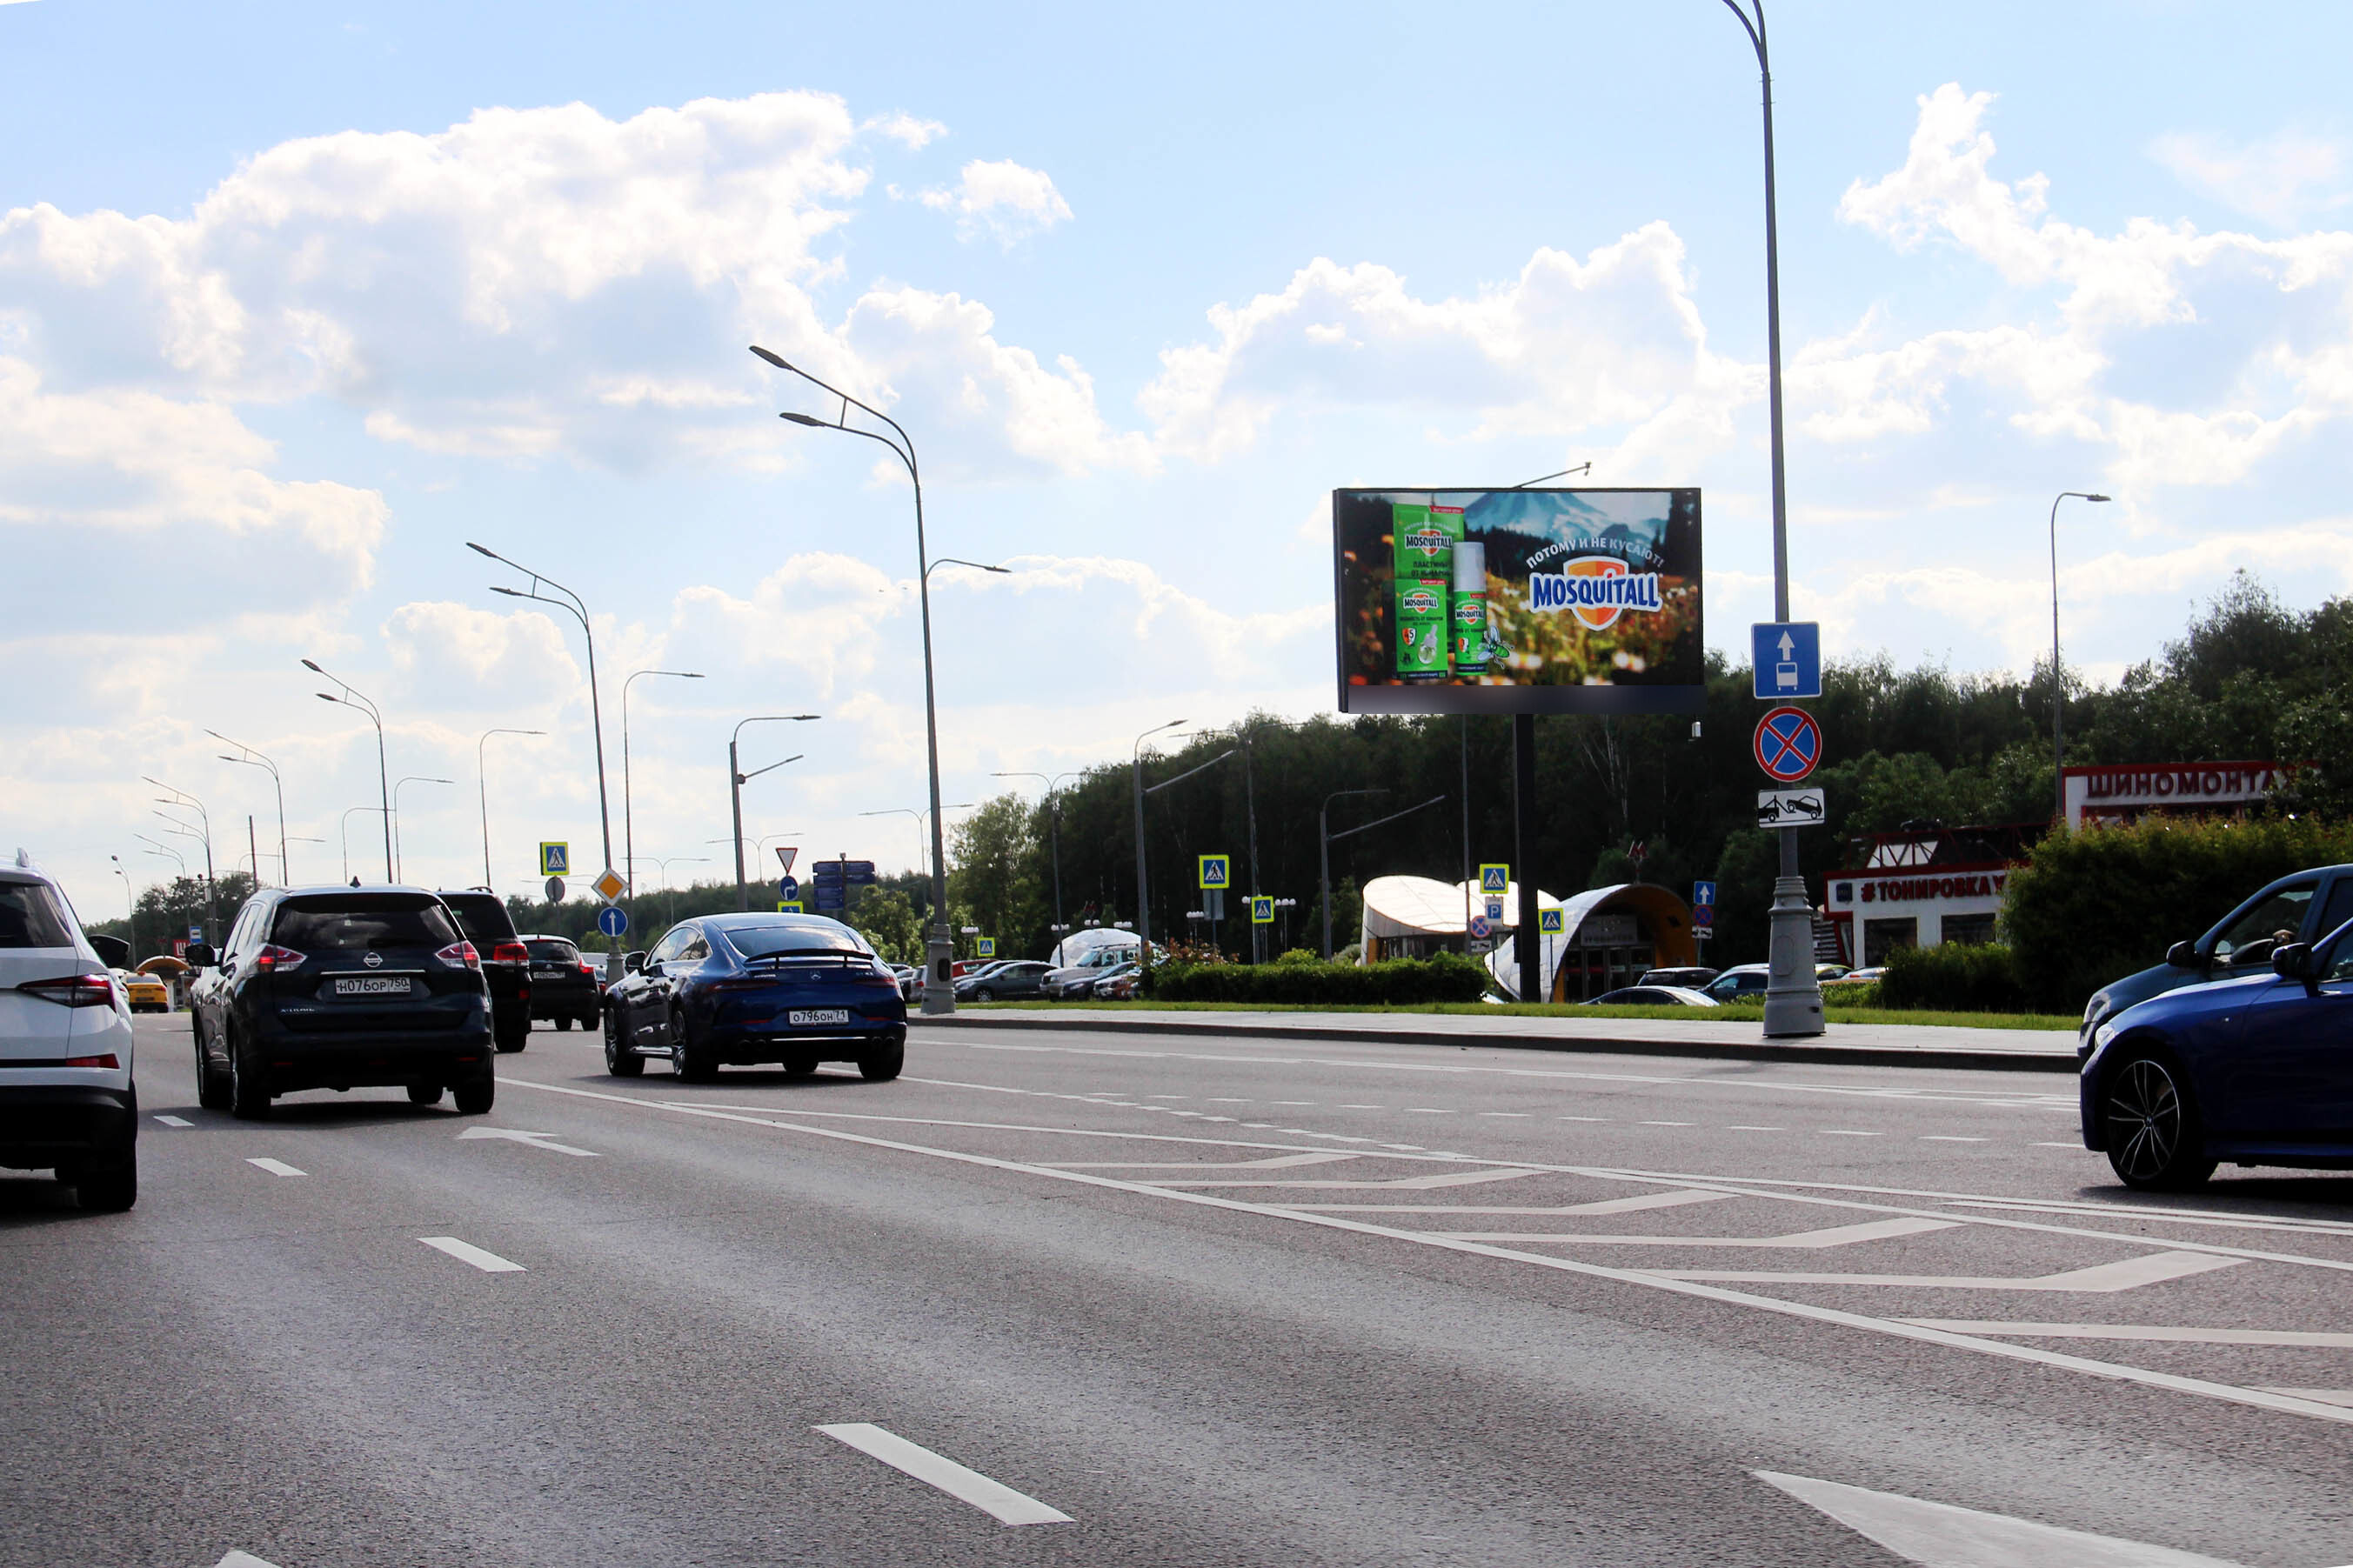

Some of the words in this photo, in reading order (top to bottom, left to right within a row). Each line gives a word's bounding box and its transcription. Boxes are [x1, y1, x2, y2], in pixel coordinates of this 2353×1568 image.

[1406, 535, 1452, 549] MOSQUITALL
[1526, 539, 1576, 569] ПОТОМУ
[1579, 538, 1588, 549] И
[1591, 537, 1607, 549] НЕ
[1609, 538, 1665, 568] КУСАЮТ!
[1532, 572, 1660, 610] MOSQUITALL
[390, 978, 406, 987] 750
[835, 1011, 845, 1019] 71
